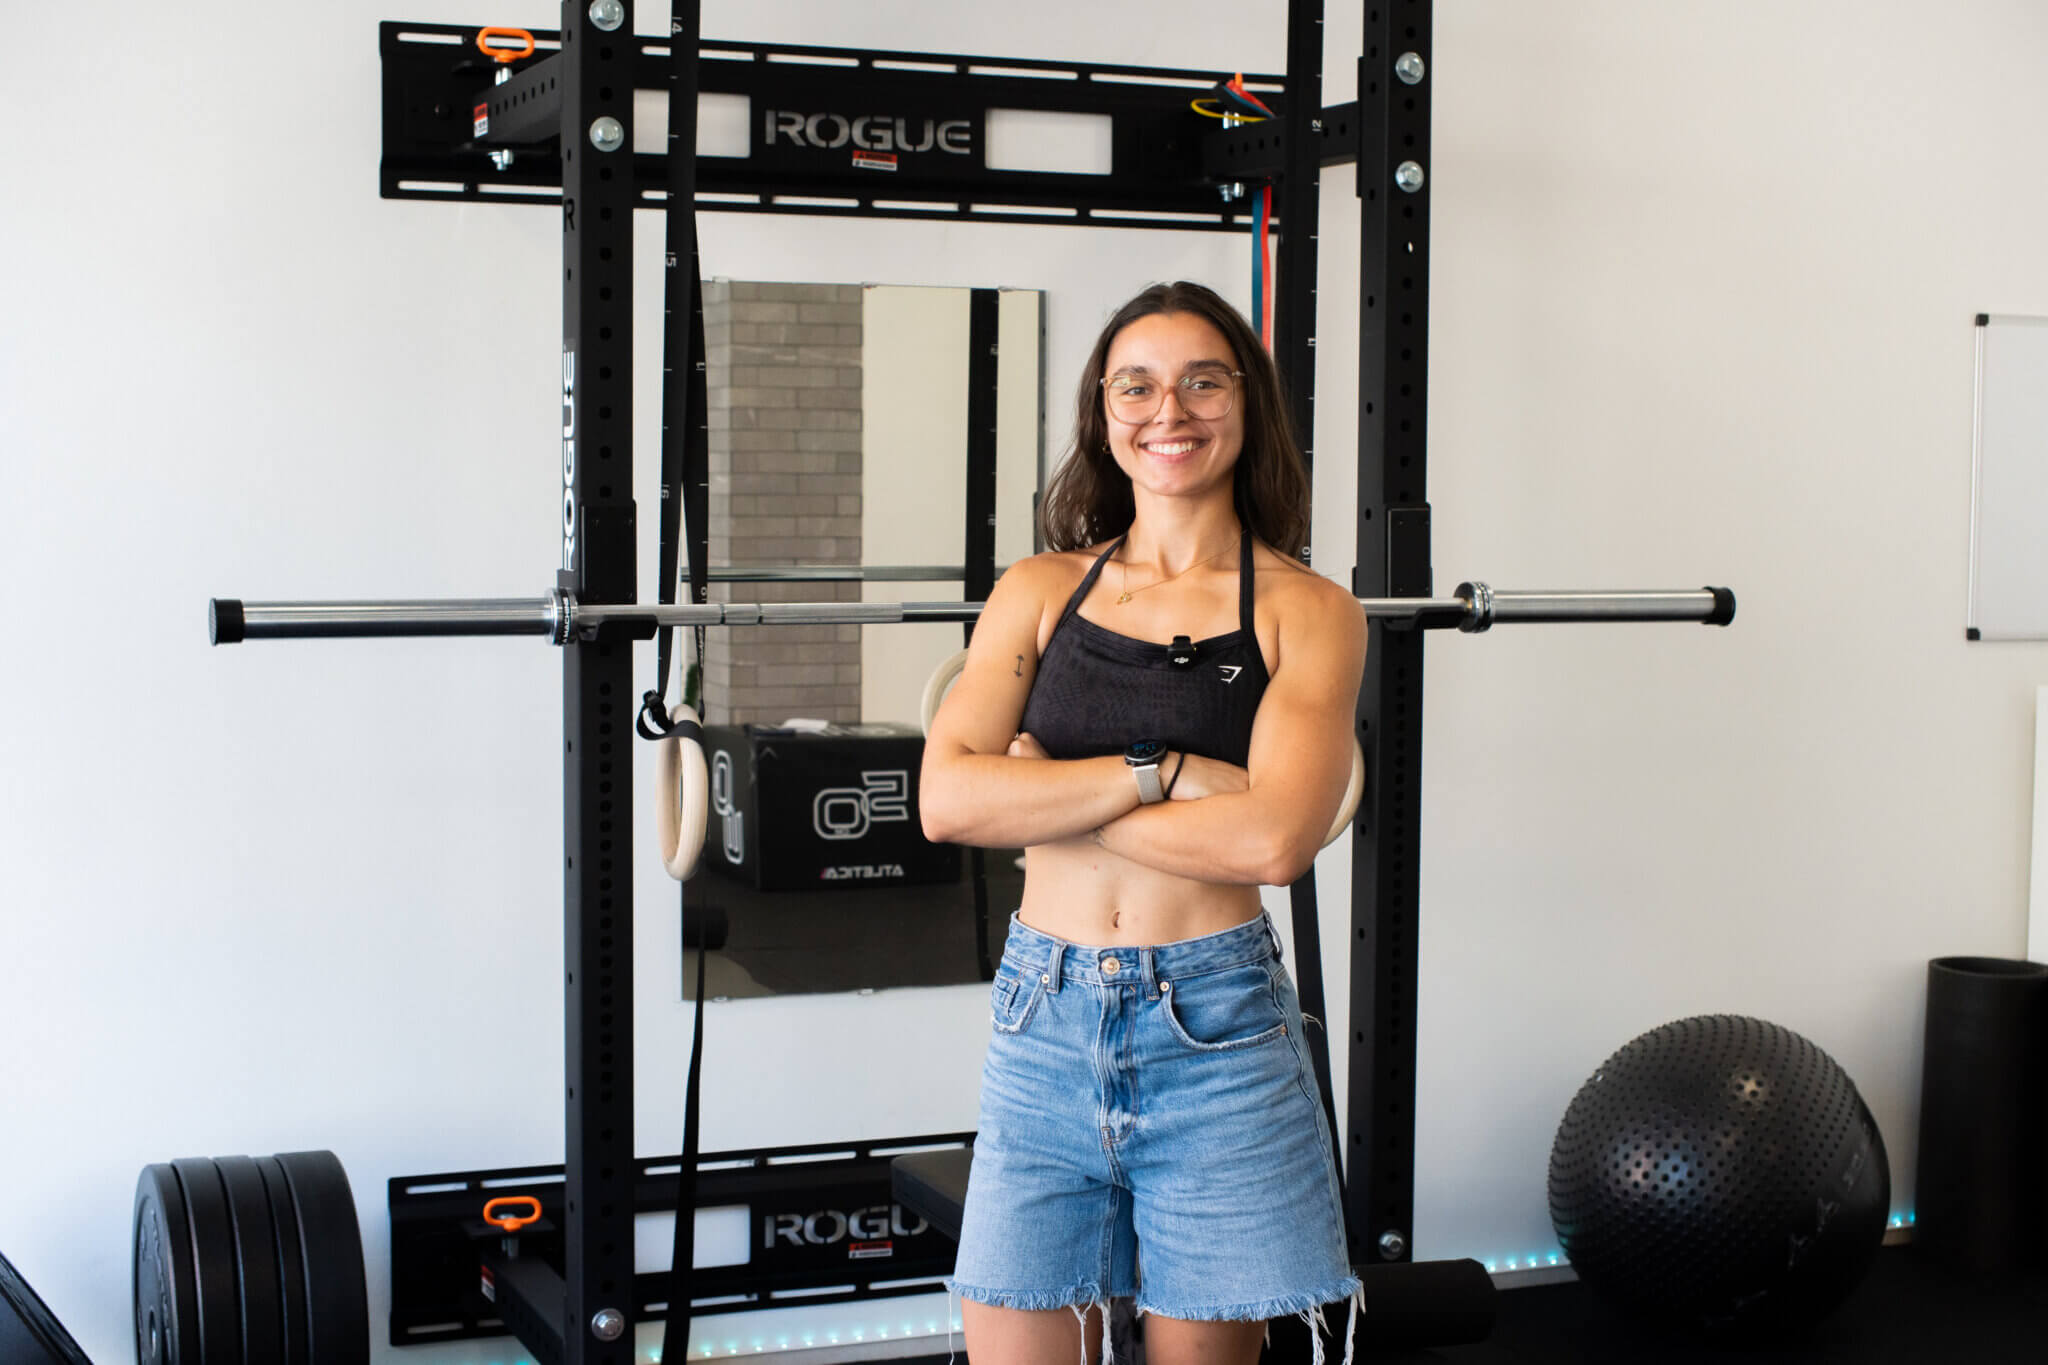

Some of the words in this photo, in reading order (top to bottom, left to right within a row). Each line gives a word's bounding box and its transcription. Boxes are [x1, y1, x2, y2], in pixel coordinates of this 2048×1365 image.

[765, 109, 971, 155] ROGUE
[563, 351, 575, 571] ROGUE
[764, 1204, 929, 1249] ROGU
